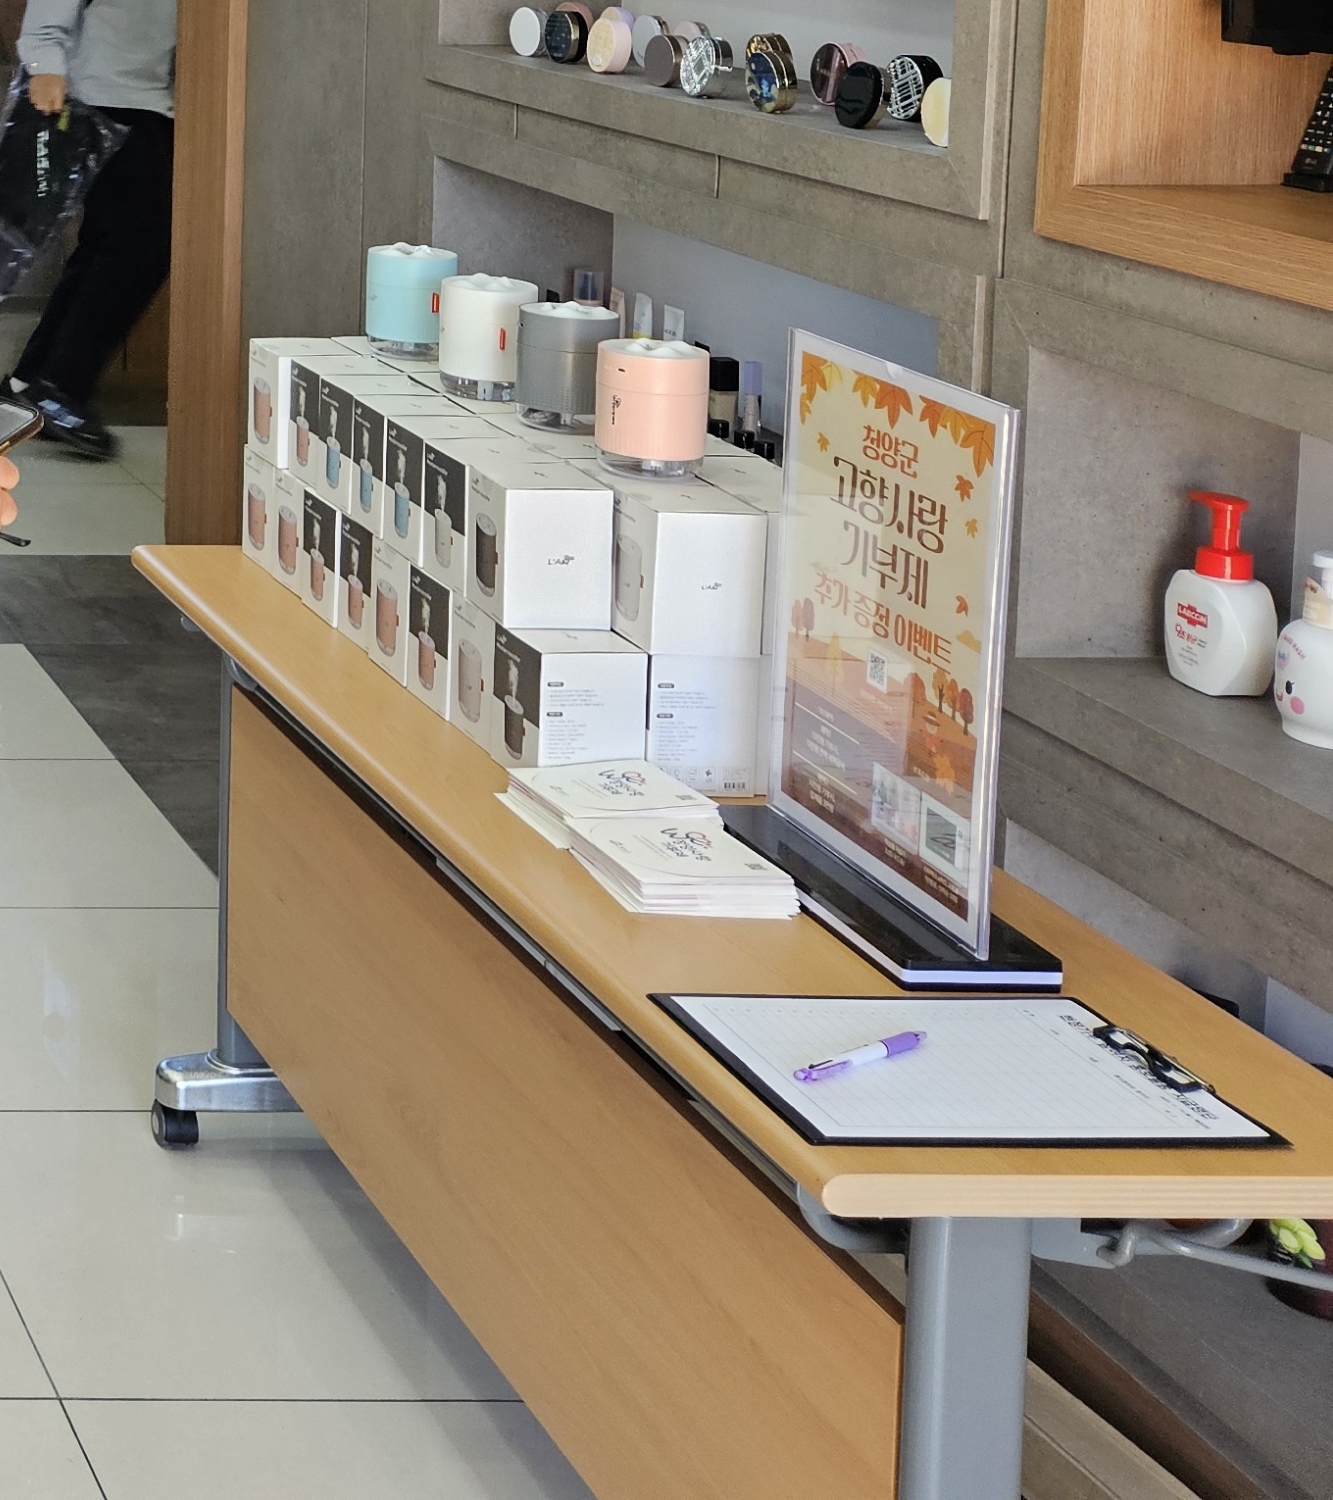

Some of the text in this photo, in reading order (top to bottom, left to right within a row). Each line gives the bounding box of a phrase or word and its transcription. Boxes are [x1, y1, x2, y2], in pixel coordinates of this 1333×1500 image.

[863, 424, 921, 479] 청양군
[831, 456, 949, 555] 고향사랑
[841, 521, 929, 610] 기부제
[813, 570, 953, 677] 추가 증정 이벤트
